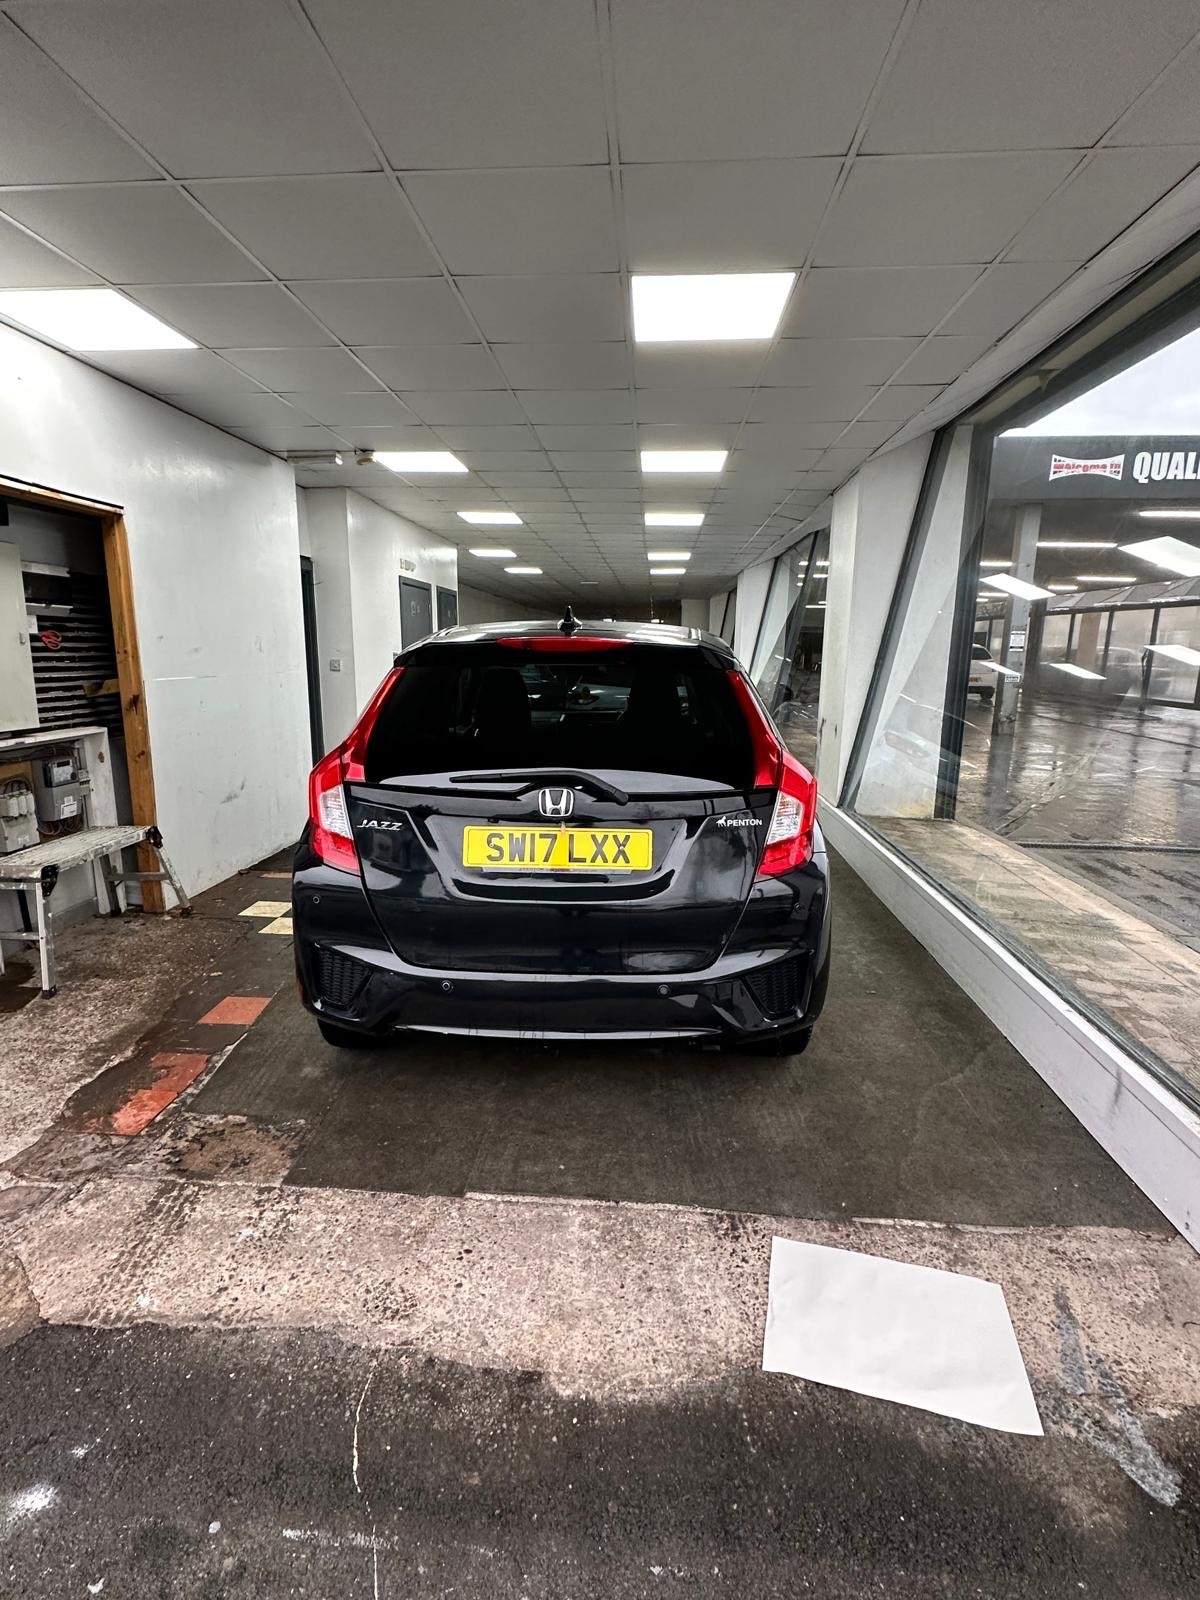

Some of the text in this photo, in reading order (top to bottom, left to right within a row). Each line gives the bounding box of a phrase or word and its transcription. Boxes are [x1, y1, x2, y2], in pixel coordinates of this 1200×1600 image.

[1133, 451, 1200, 483] QUAL
[356, 819, 403, 831] JAZZ
[726, 818, 763, 827] PENTON
[486, 832, 631, 864] SW17 LXX
